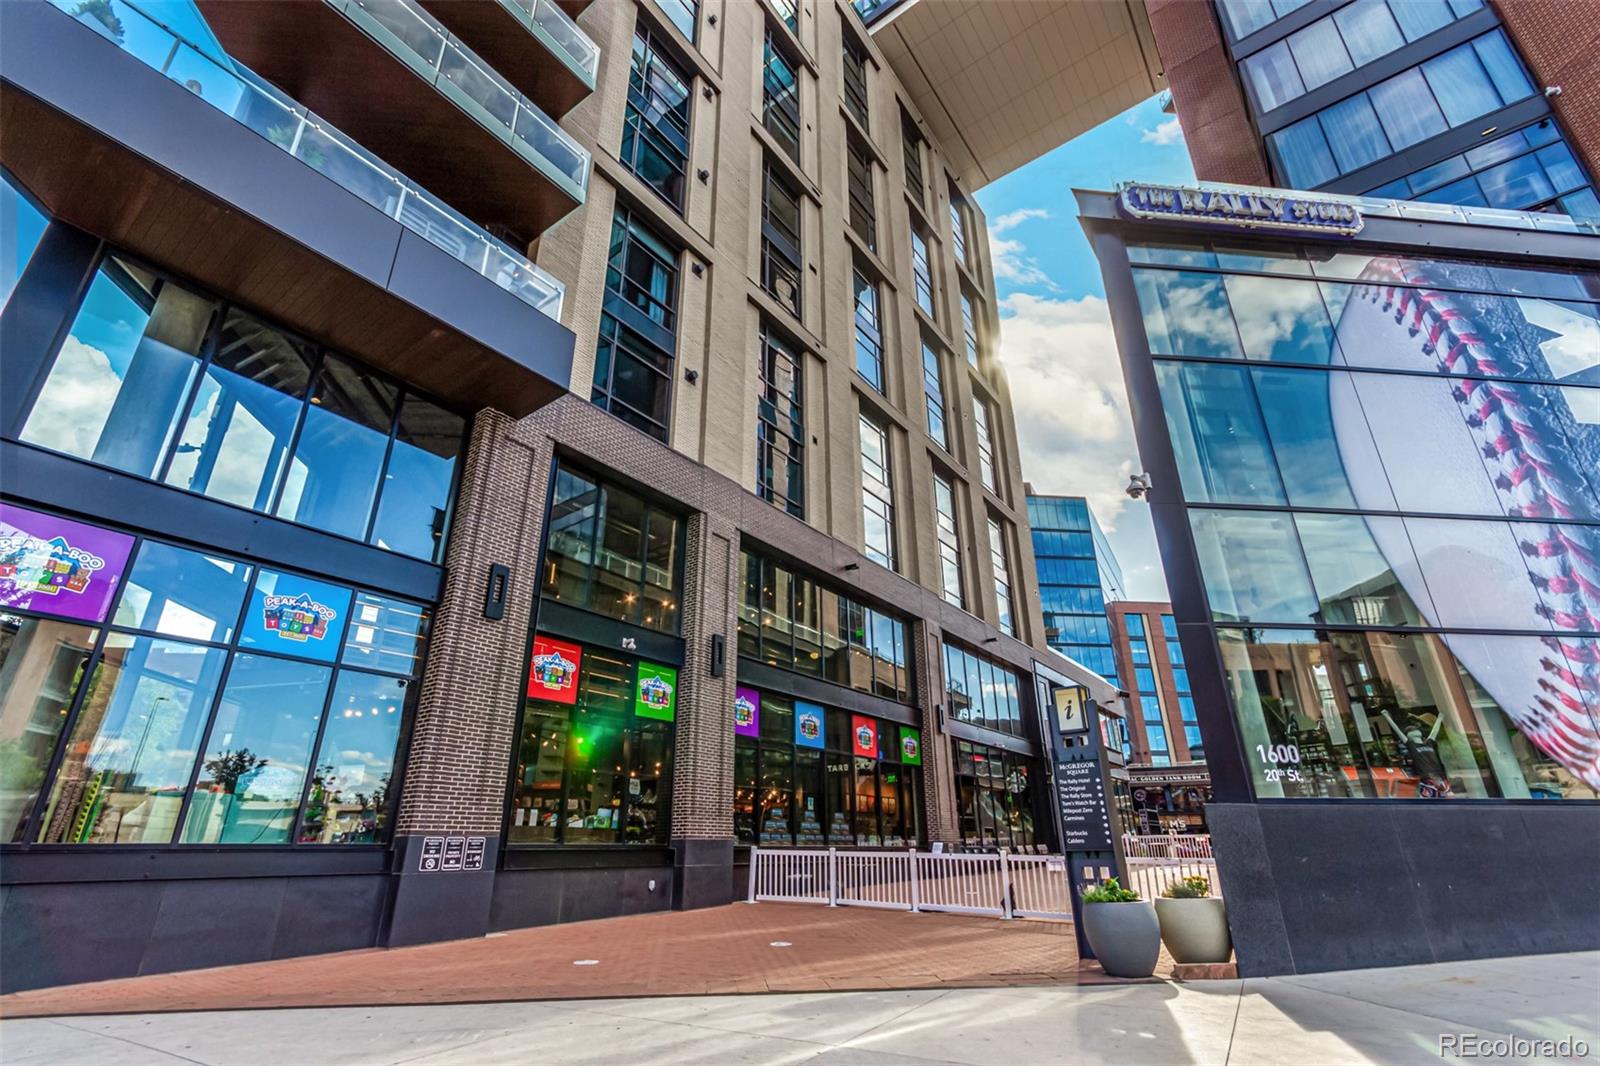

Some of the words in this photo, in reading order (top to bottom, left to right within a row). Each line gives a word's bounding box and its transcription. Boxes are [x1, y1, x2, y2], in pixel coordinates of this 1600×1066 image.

[1135, 188, 1175, 207] THE
[1178, 190, 1287, 217] RALLY
[265, 597, 334, 618] PEAK-A-BOO
[1256, 744, 1300, 763] 1600
[1264, 769, 1286, 782] 20th
[1287, 769, 1304, 783] St.
